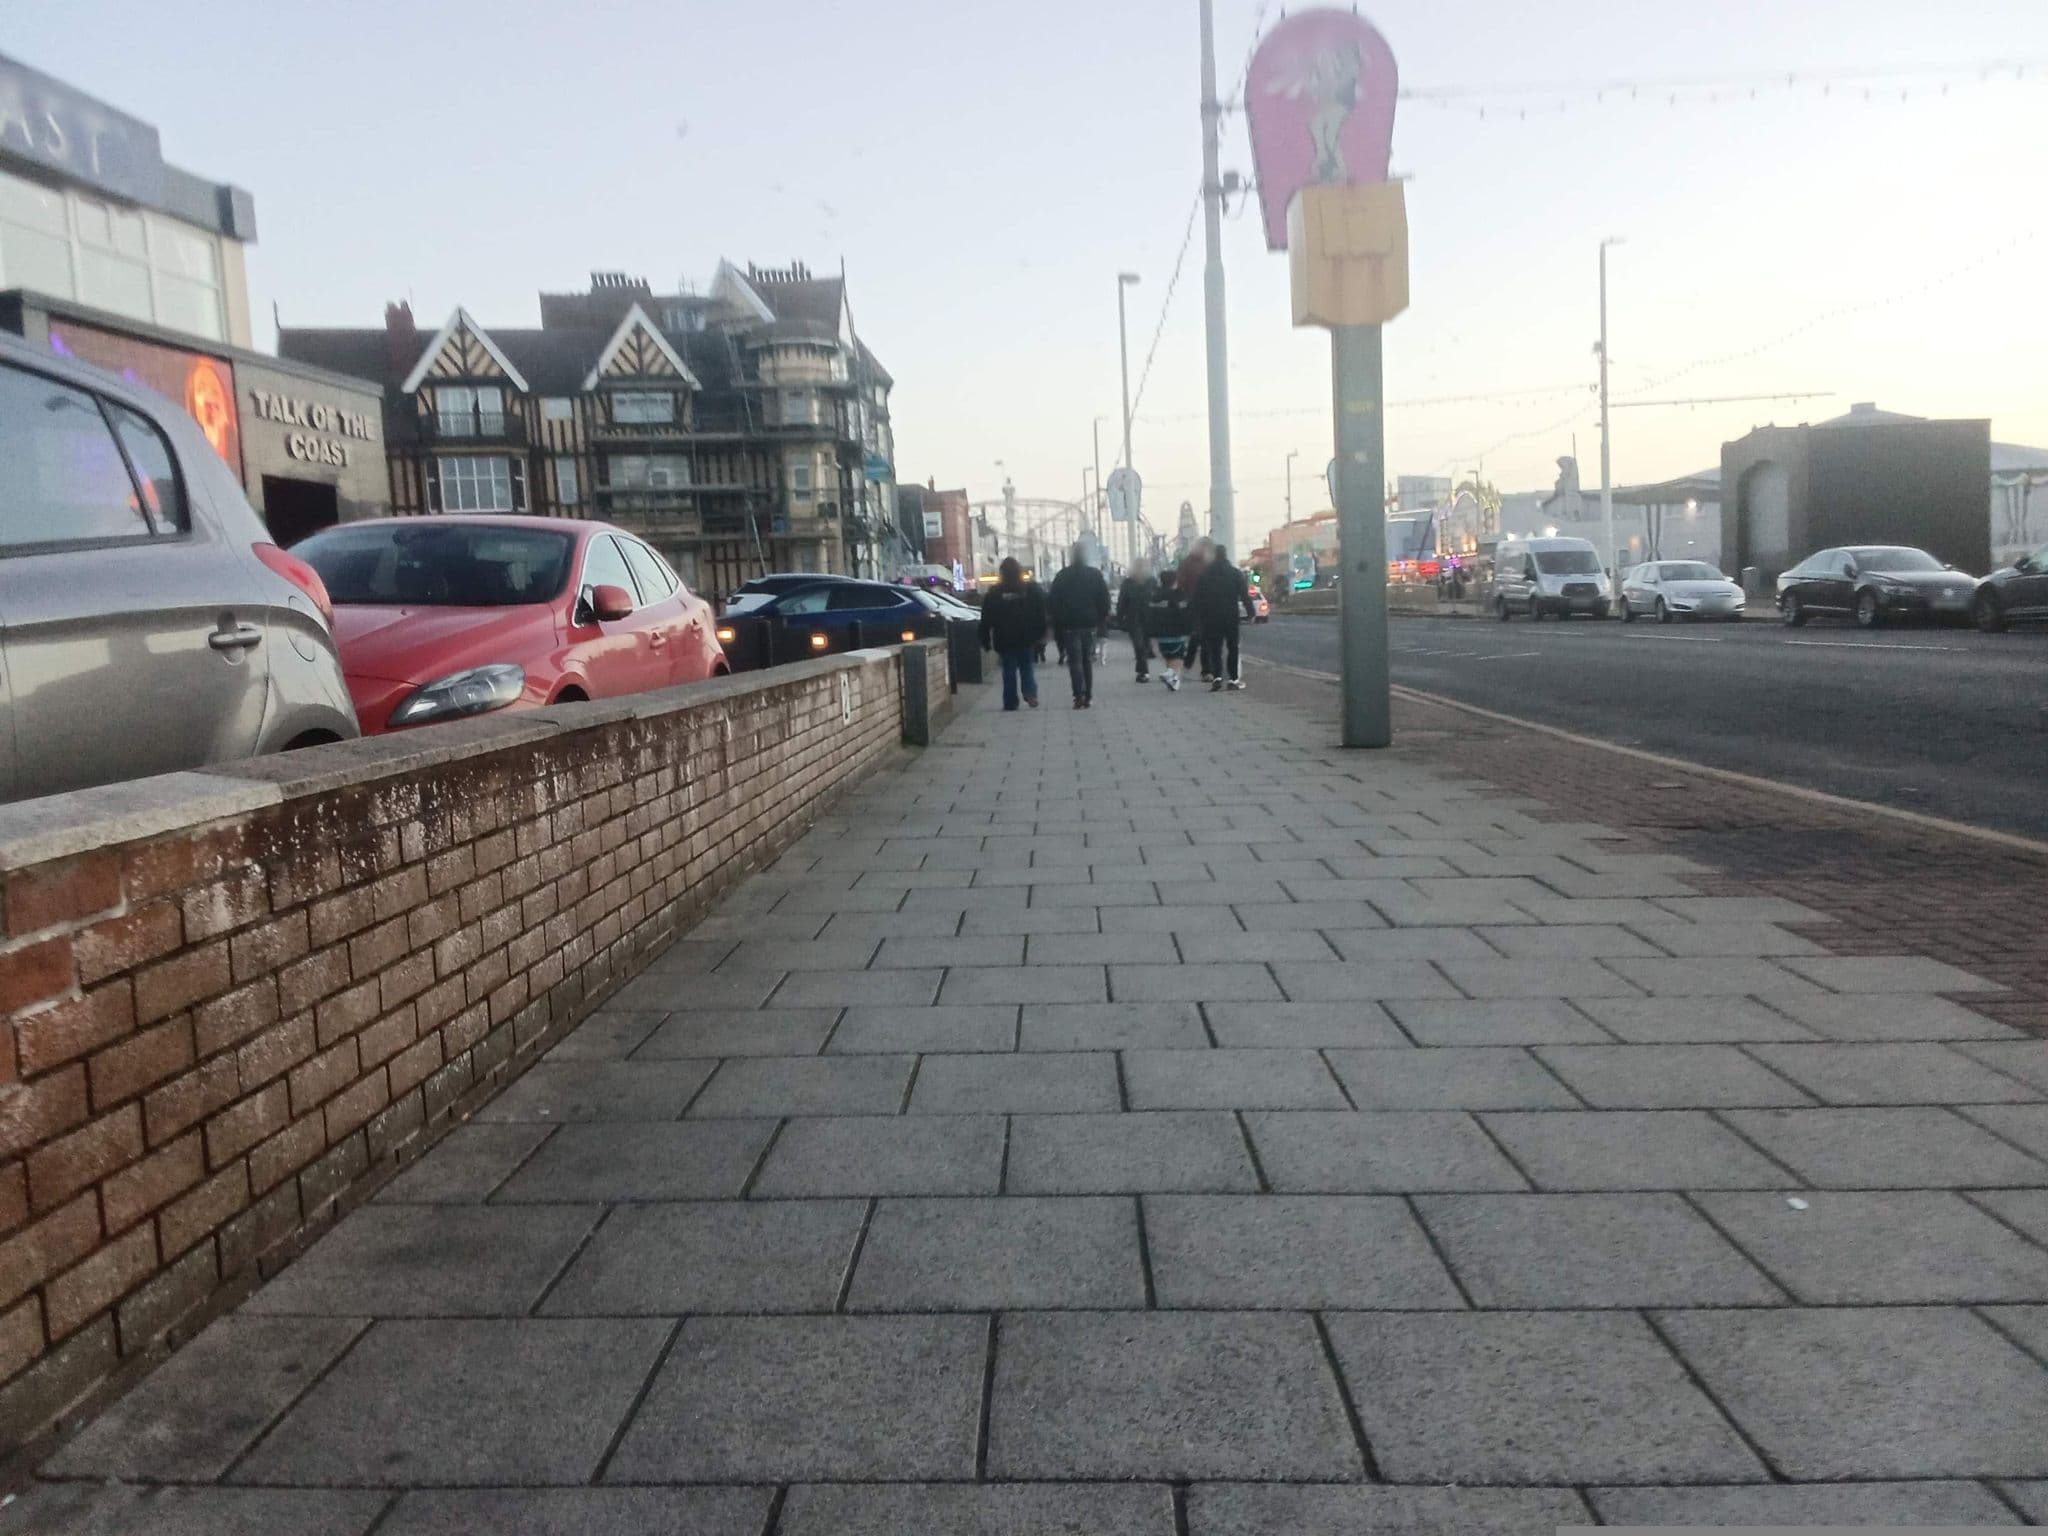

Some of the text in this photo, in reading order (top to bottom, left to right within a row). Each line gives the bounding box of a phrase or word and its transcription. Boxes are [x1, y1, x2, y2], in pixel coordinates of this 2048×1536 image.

[251, 387, 377, 441] TALK OF THE
[287, 431, 350, 466] COAST
